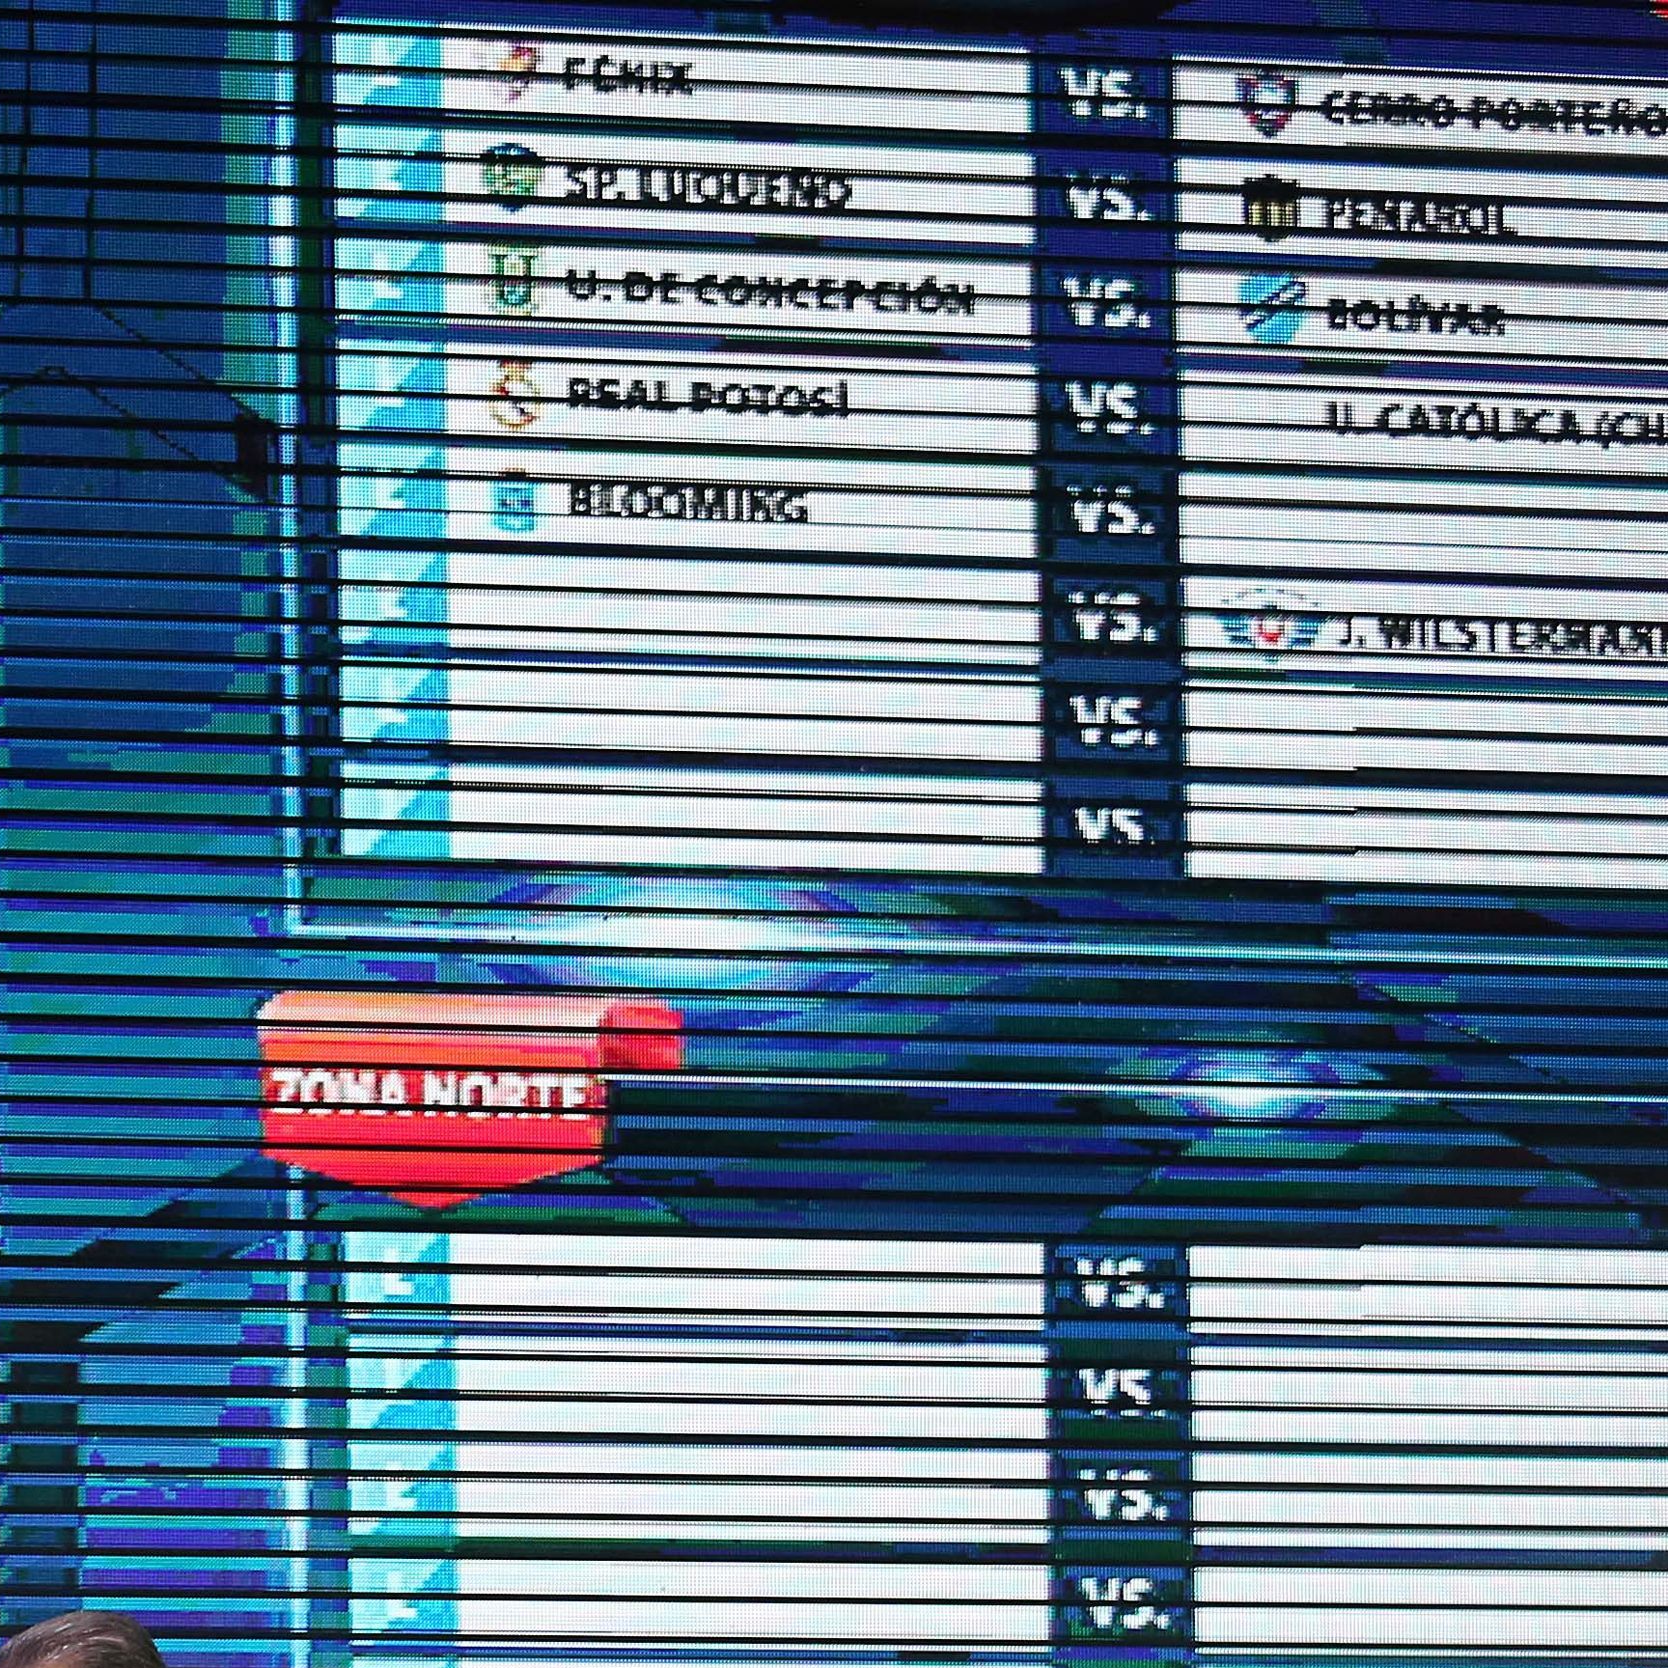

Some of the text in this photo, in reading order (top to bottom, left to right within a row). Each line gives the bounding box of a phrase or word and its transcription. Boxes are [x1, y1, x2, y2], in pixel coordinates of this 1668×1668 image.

[624, 271, 682, 305] DE
[271, 1069, 591, 1121] ZONA NORTE
